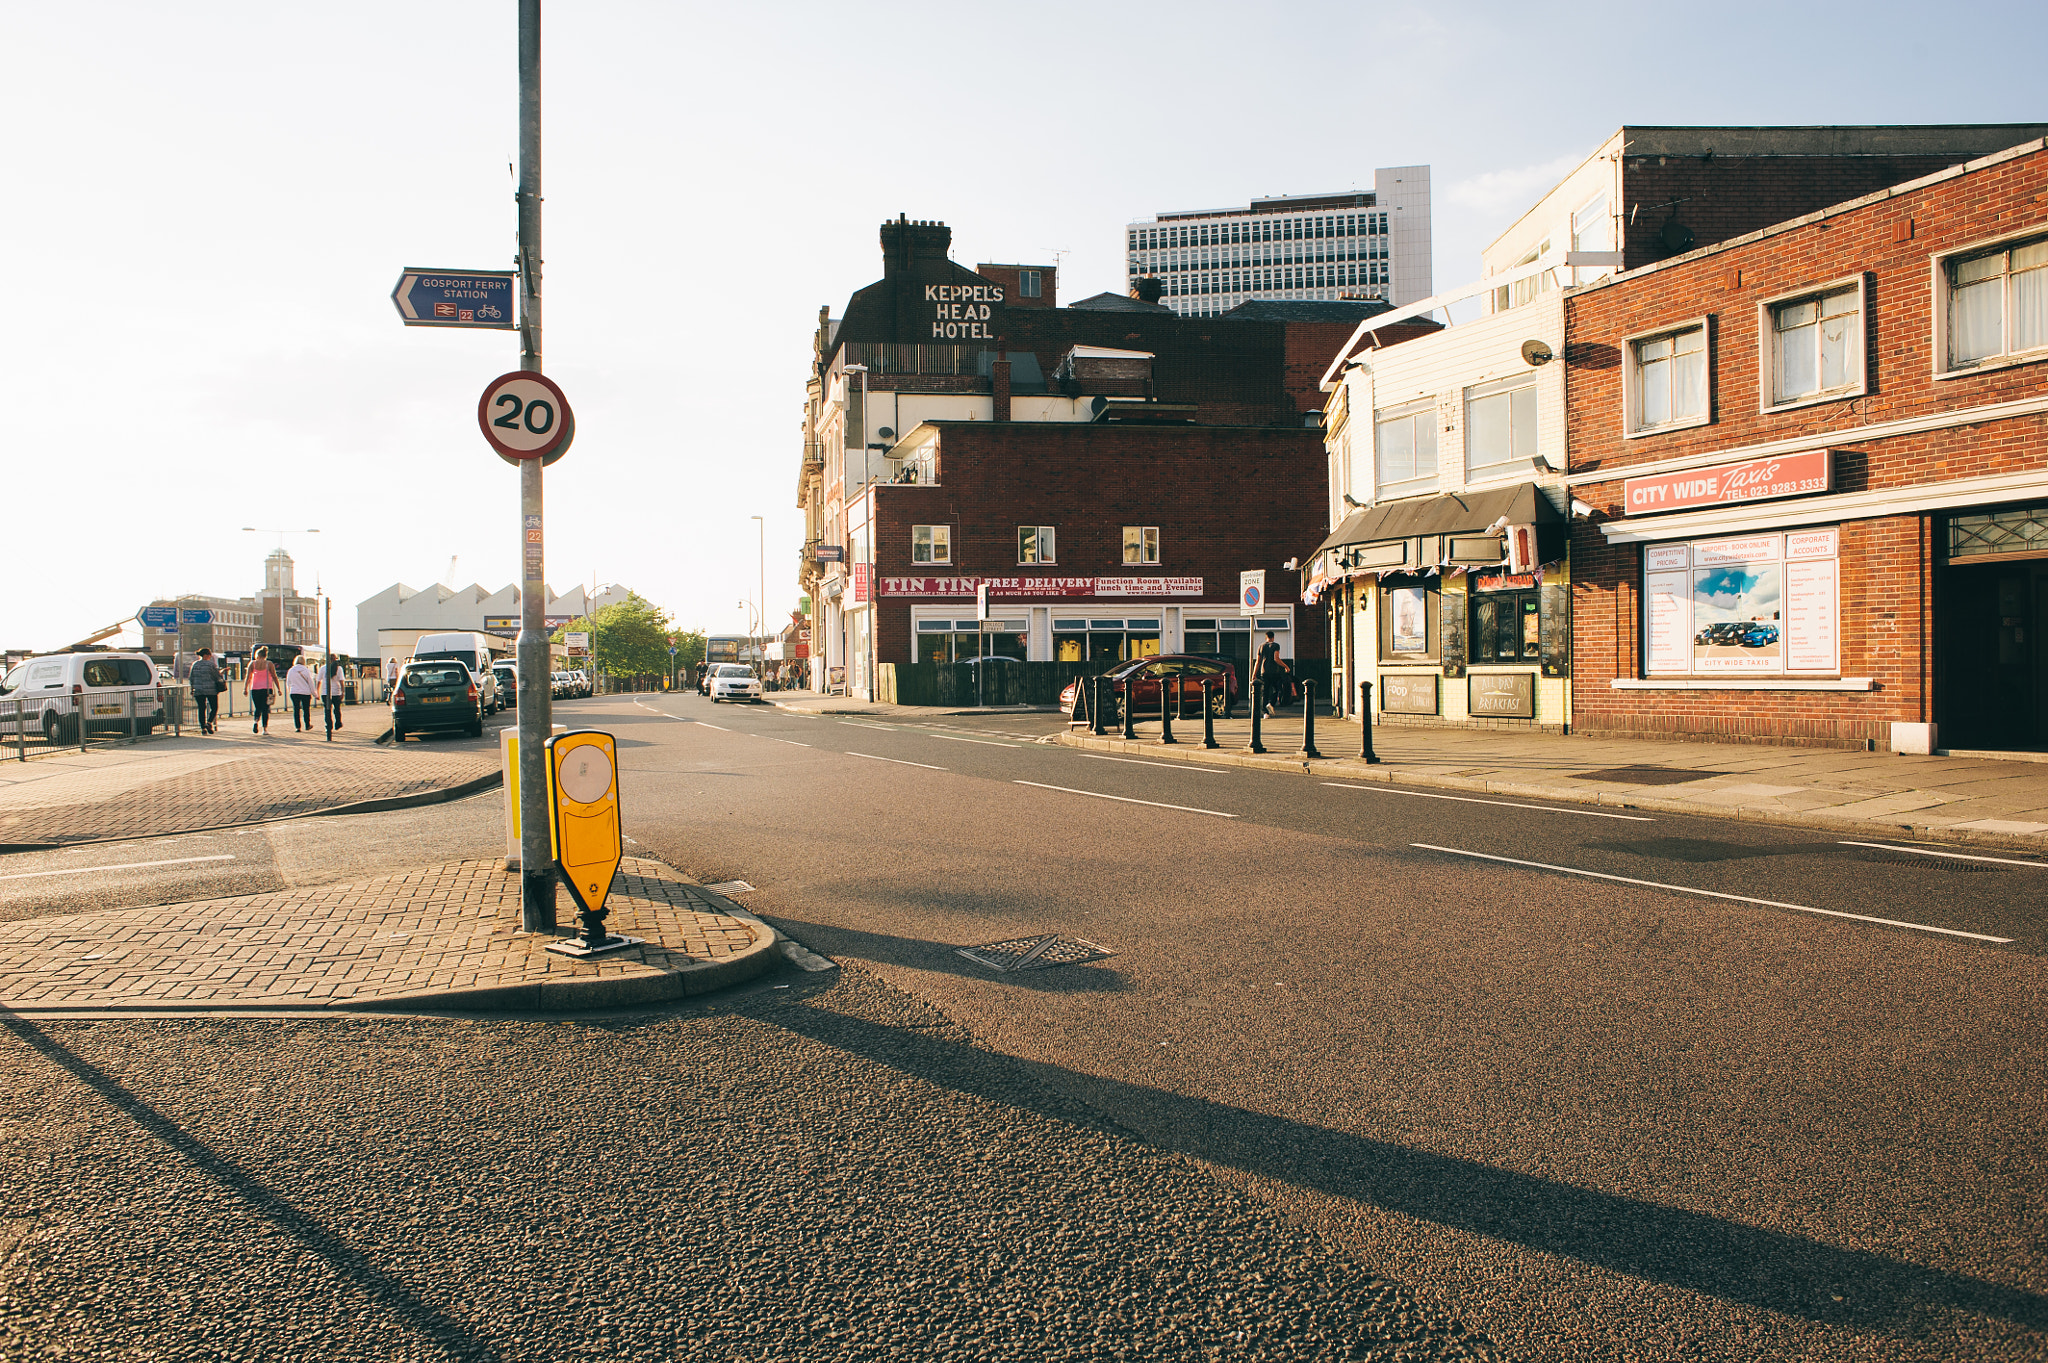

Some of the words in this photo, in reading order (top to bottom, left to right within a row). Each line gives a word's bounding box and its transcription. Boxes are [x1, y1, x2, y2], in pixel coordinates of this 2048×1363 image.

[423, 279, 472, 288] GOSPORT
[475, 281, 508, 290] FERRY
[444, 290, 488, 299] STATION
[925, 285, 1004, 302] KEPPEL'S
[461, 312, 472, 320] 22
[936, 304, 990, 320] HEAD
[932, 322, 994, 339] HOTEL
[494, 394, 554, 434] 20
[1718, 460, 1781, 499] Taxis
[1633, 484, 1668, 505] CITY
[1673, 478, 1718, 500] WIDE
[1726, 489, 1748, 500] TEL:
[1750, 486, 1769, 498] 023
[1772, 481, 1797, 495] 9283
[1800, 477, 1826, 491] 3333
[529, 532, 541, 540] 22
[1792, 535, 1830, 545] CORPORATE
[1702, 544, 1728, 552] AIRPORTS
[1732, 542, 1749, 550] BOOK
[1750, 541, 1770, 549] ONLINE
[1794, 546, 1828, 554] ACCOUNTS
[1650, 549, 1685, 558] COMPETITIVE
[1656, 559, 1678, 567] PRICING
[884, 578, 925, 591] TIN
[935, 578, 976, 591] TIN
[985, 578, 1019, 587] FREE
[1025, 578, 1093, 587] DELIVERY
[1507, 575, 1533, 586] KEBAB
[1481, 677, 1496, 690] ALL
[1499, 676, 1514, 690] DAY
[1387, 685, 1407, 696] FOOD
[1478, 697, 1520, 710] BREAKFAST
